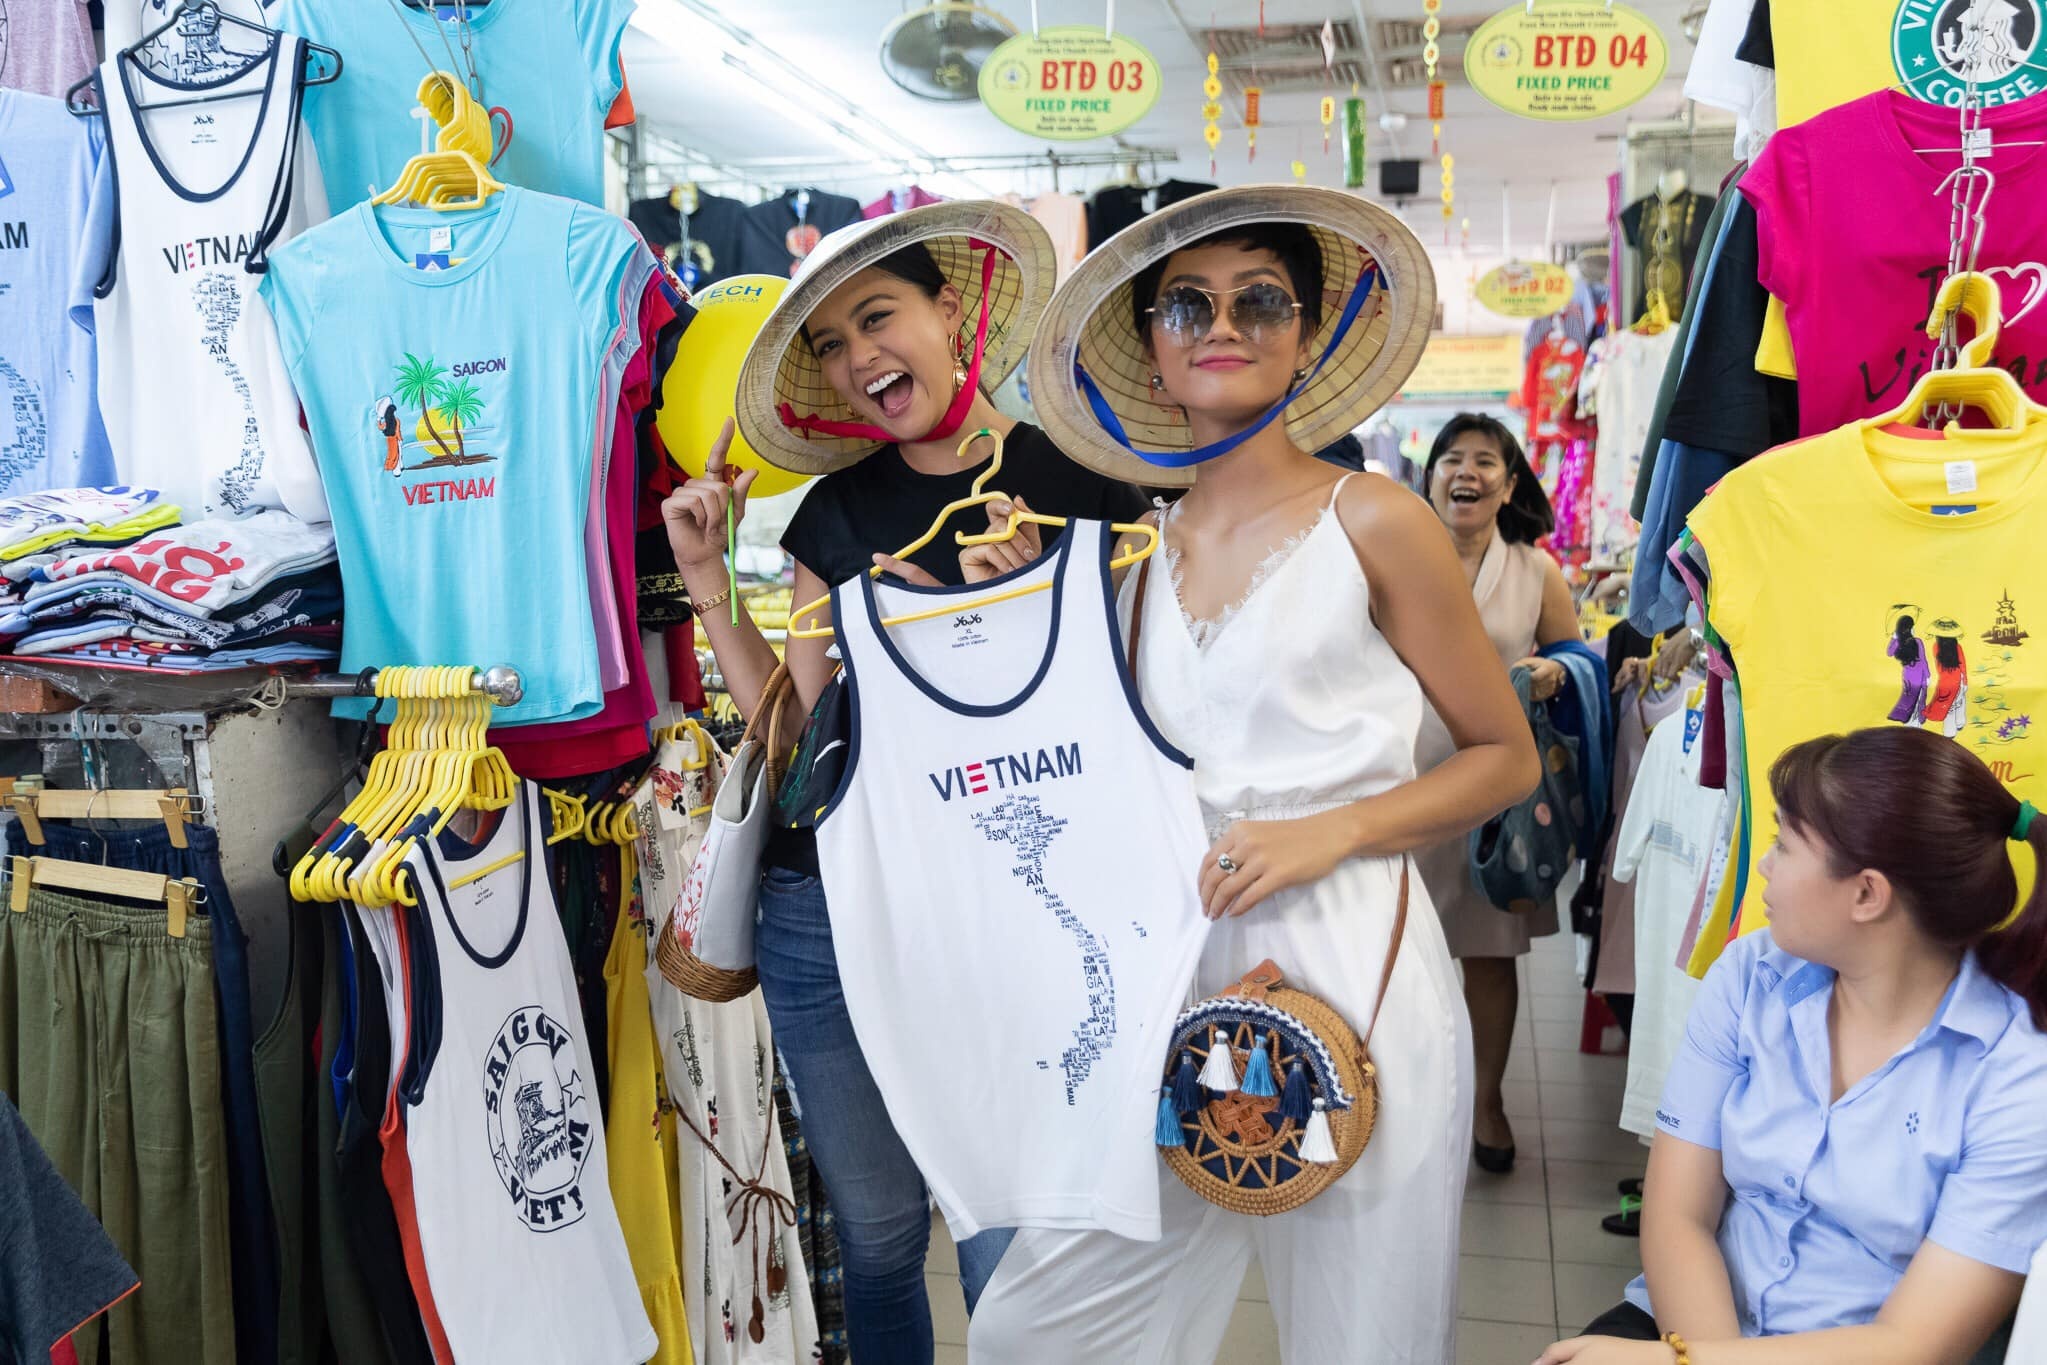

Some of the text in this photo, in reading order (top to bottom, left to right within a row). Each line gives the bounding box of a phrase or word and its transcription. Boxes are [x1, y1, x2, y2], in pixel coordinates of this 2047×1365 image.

[1533, 34, 1596, 69] BTĐ
[1608, 34, 1648, 68] 04
[1041, 60, 1097, 92] BTĐ
[1108, 60, 1143, 93] 03
[1516, 75, 1612, 90] FIXED PRICE
[1026, 99, 1112, 113] FIXED PRICE
[1544, 277, 1566, 294] 02
[452, 357, 506, 378] SAIGON
[402, 476, 496, 507] VIETNAM
[928, 742, 1082, 802] VIETNAM
[991, 827, 1009, 842] SON
[1012, 864, 1034, 878] NGHE
[1026, 873, 1044, 887] AN
[1034, 886, 1049, 896] HA
[1055, 908, 1071, 917] BINH
[1083, 964, 1099, 976] TUM
[1086, 975, 1105, 989] GIA
[1093, 1025, 1108, 1037] LAT
